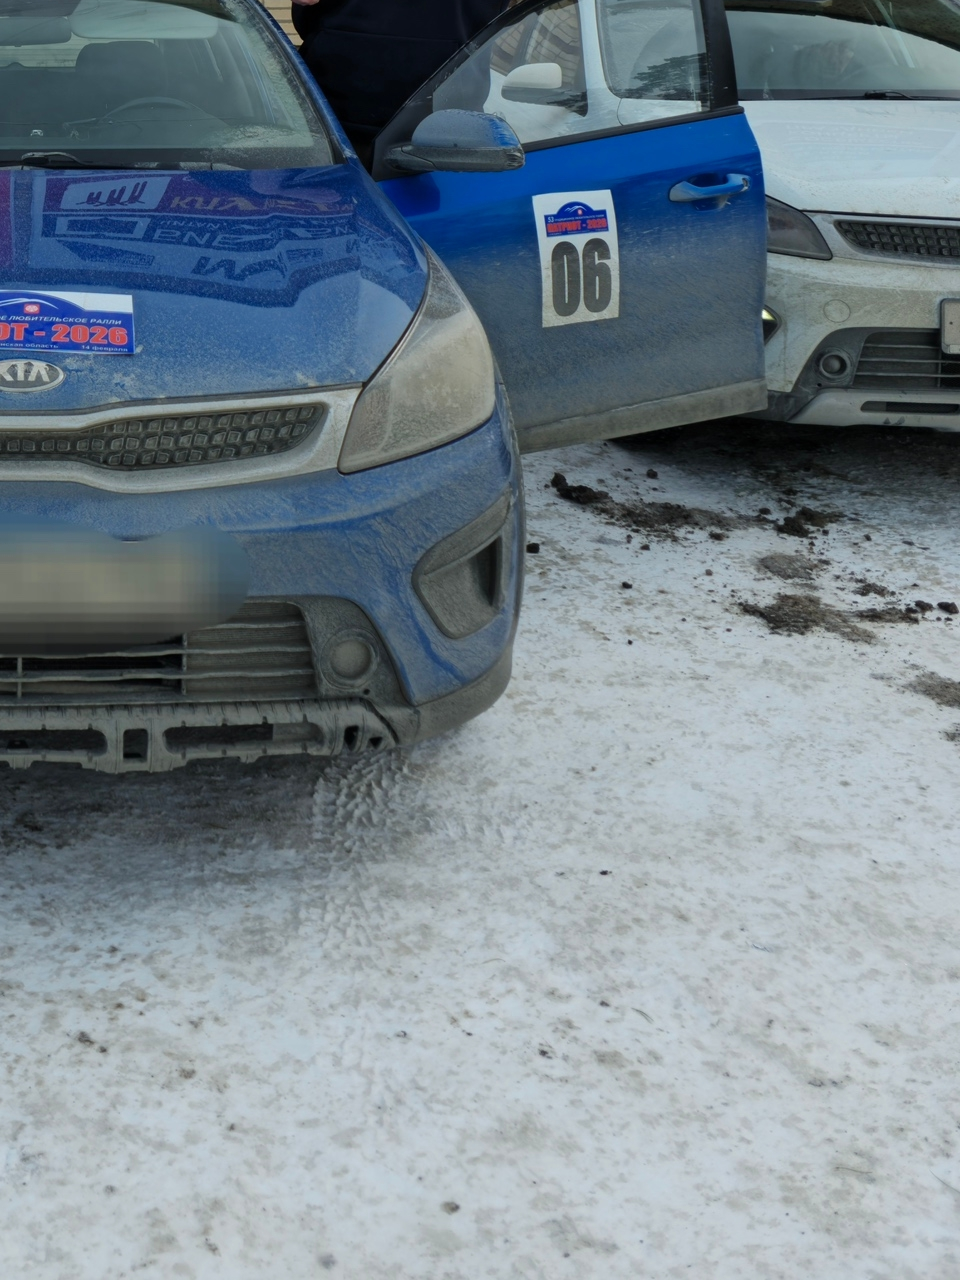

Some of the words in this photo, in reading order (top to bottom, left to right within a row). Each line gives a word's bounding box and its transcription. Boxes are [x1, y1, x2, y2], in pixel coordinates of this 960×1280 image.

[551, 238, 612, 317] 06
[9, 315, 88, 323] ЛЮБИТЕЛЬСКОЕ
[51, 324, 128, 345] 2026
